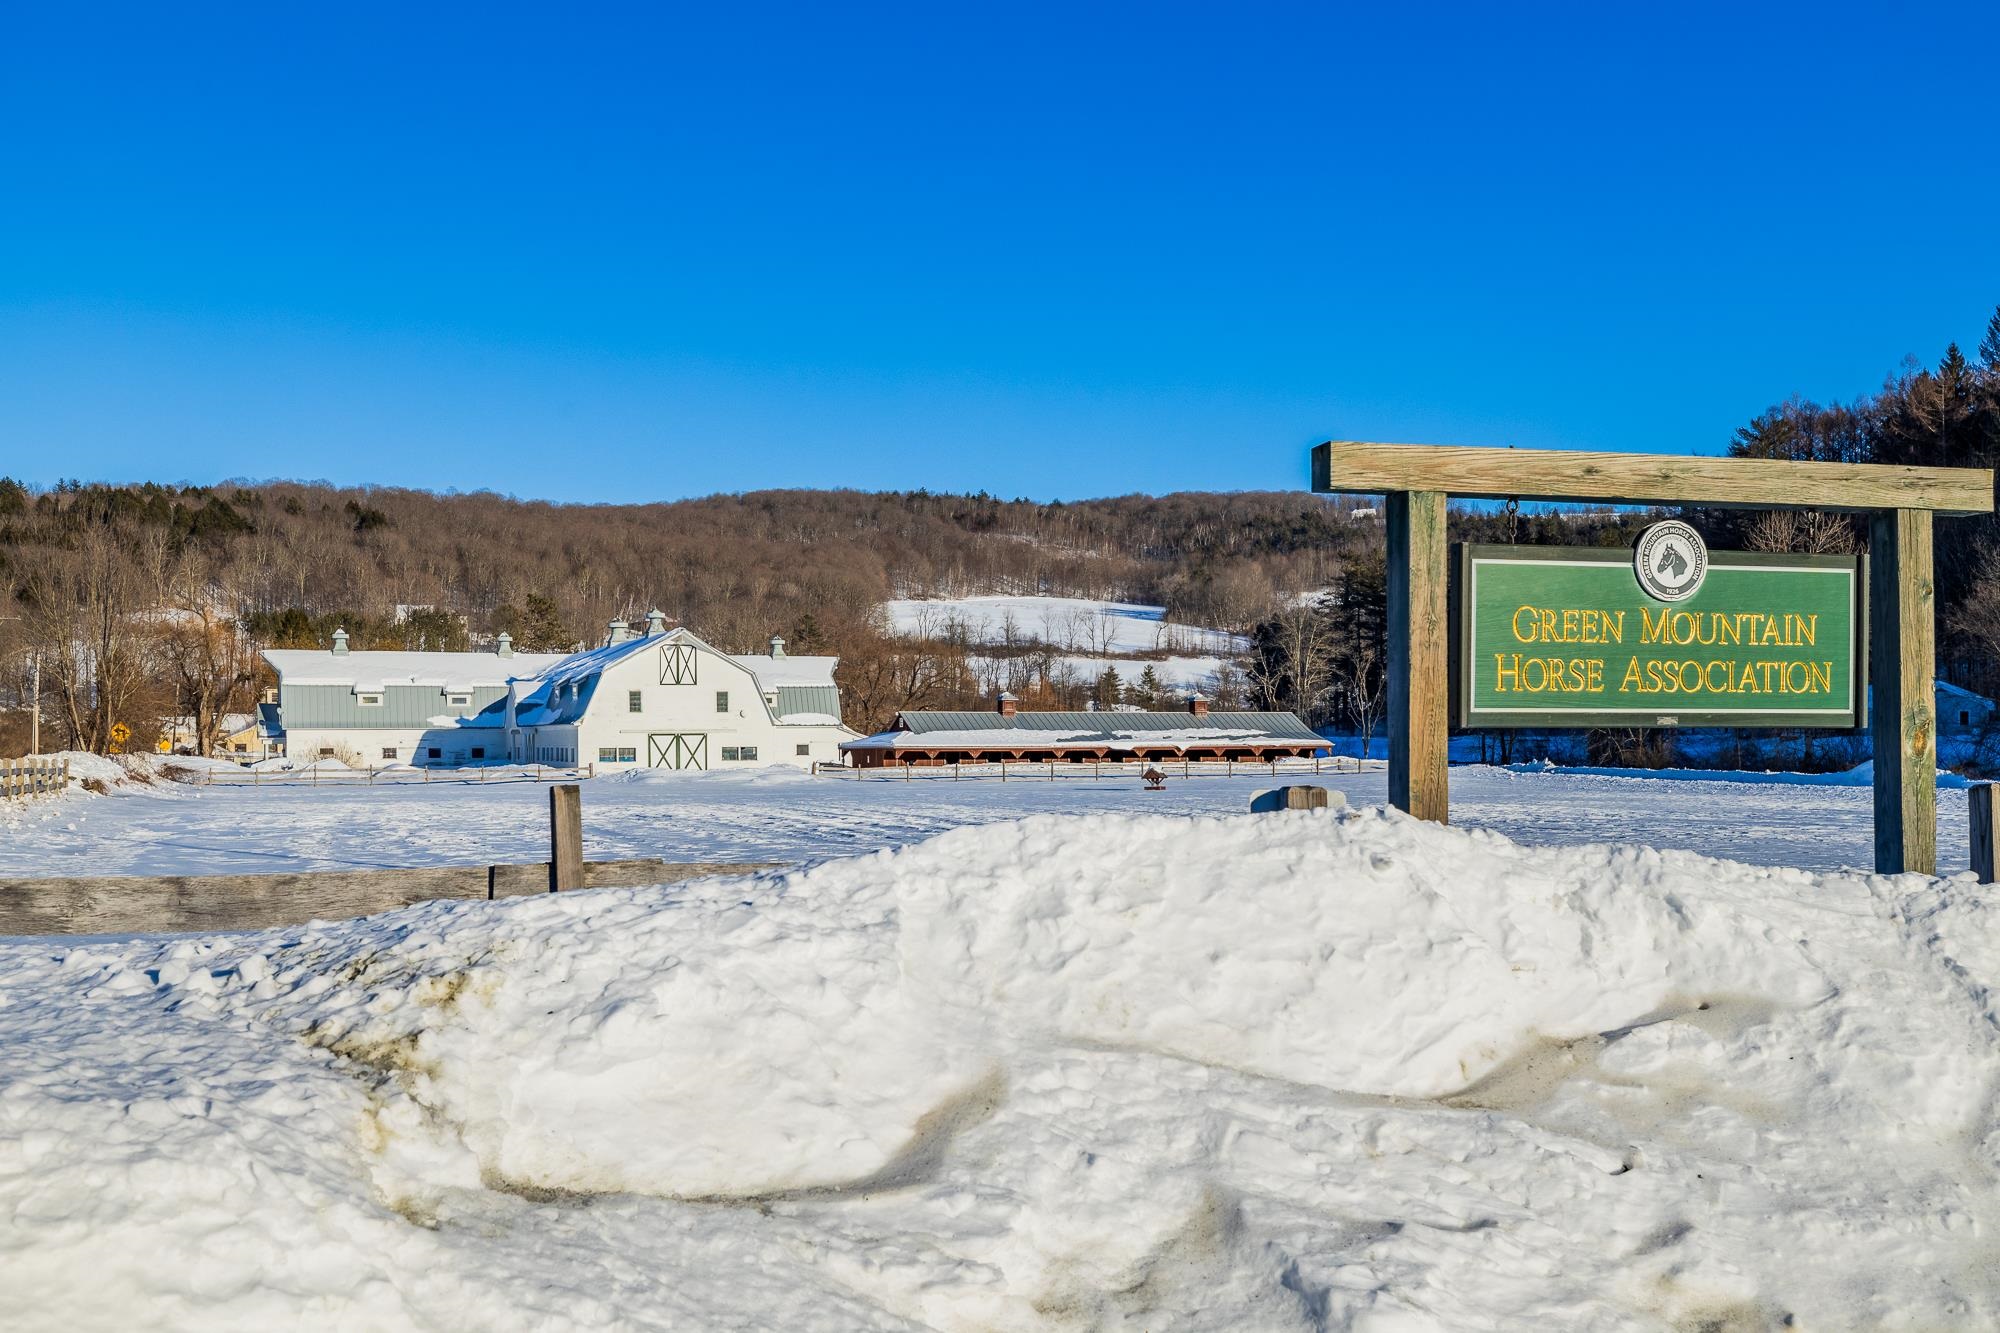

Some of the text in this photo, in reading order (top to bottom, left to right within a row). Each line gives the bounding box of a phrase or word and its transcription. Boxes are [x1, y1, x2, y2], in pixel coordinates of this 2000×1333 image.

[1644, 528, 1669, 556] MOUNTAIN
[1669, 527, 1691, 539] HORSE
[1643, 556, 1653, 579] GREEN
[1688, 537, 1702, 581] ASSOCIATION
[1512, 605, 1818, 646] GREEN MOUNTAIN
[1494, 653, 1833, 694] HORSE ASSOCIATION
